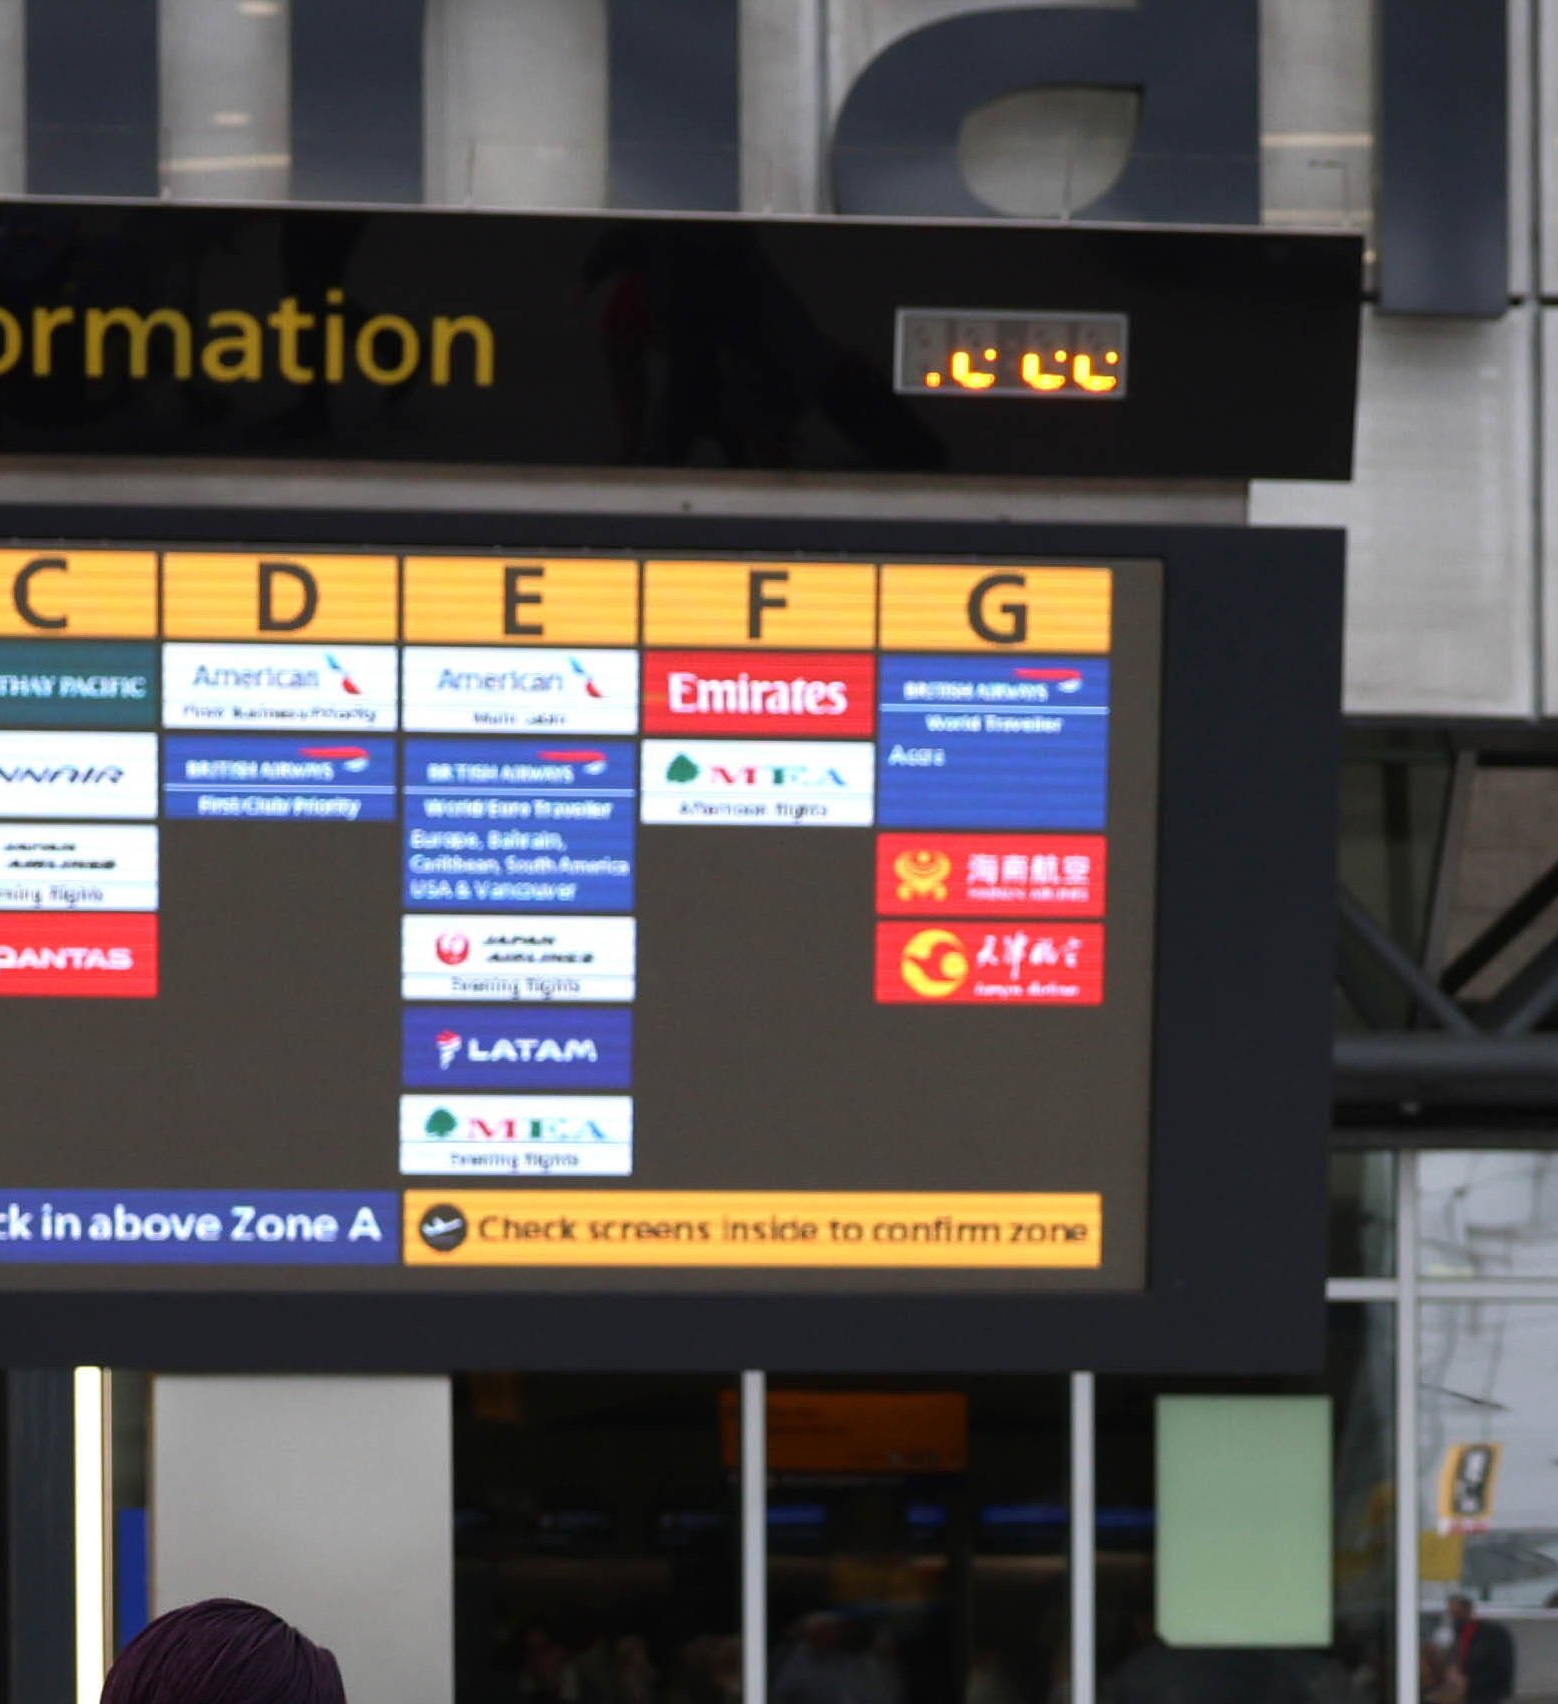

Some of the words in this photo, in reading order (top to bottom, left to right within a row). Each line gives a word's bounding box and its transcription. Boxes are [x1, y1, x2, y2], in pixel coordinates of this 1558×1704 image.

[12, 557, 69, 629] C
[258, 561, 320, 632] D
[503, 566, 546, 637] E
[748, 570, 789, 640] F
[967, 574, 1028, 644] G
[59, 675, 147, 699] PACIFIC
[191, 664, 320, 690] American
[437, 667, 563, 692] American
[667, 671, 848, 716] Emirates
[185, 759, 258, 781] BRITISH
[259, 760, 335, 782] AIRWAYS
[426, 762, 499, 784] BRITISH
[500, 763, 575, 785] AIRWAYS
[504, 854, 557, 875] South
[558, 855, 631, 877] America
[409, 879, 453, 900] USA
[467, 1037, 599, 1063] LATAM
[39, 1202, 82, 1242] in
[88, 1202, 223, 1242] above
[230, 1205, 339, 1243] Zone
[348, 1206, 383, 1242] A
[478, 1215, 576, 1245] Check
[588, 1218, 711, 1245] screens
[721, 1214, 818, 1245] inside
[830, 1218, 864, 1245] to
[872, 1216, 1002, 1246] confirm
[1011, 1222, 1090, 1246] zone
